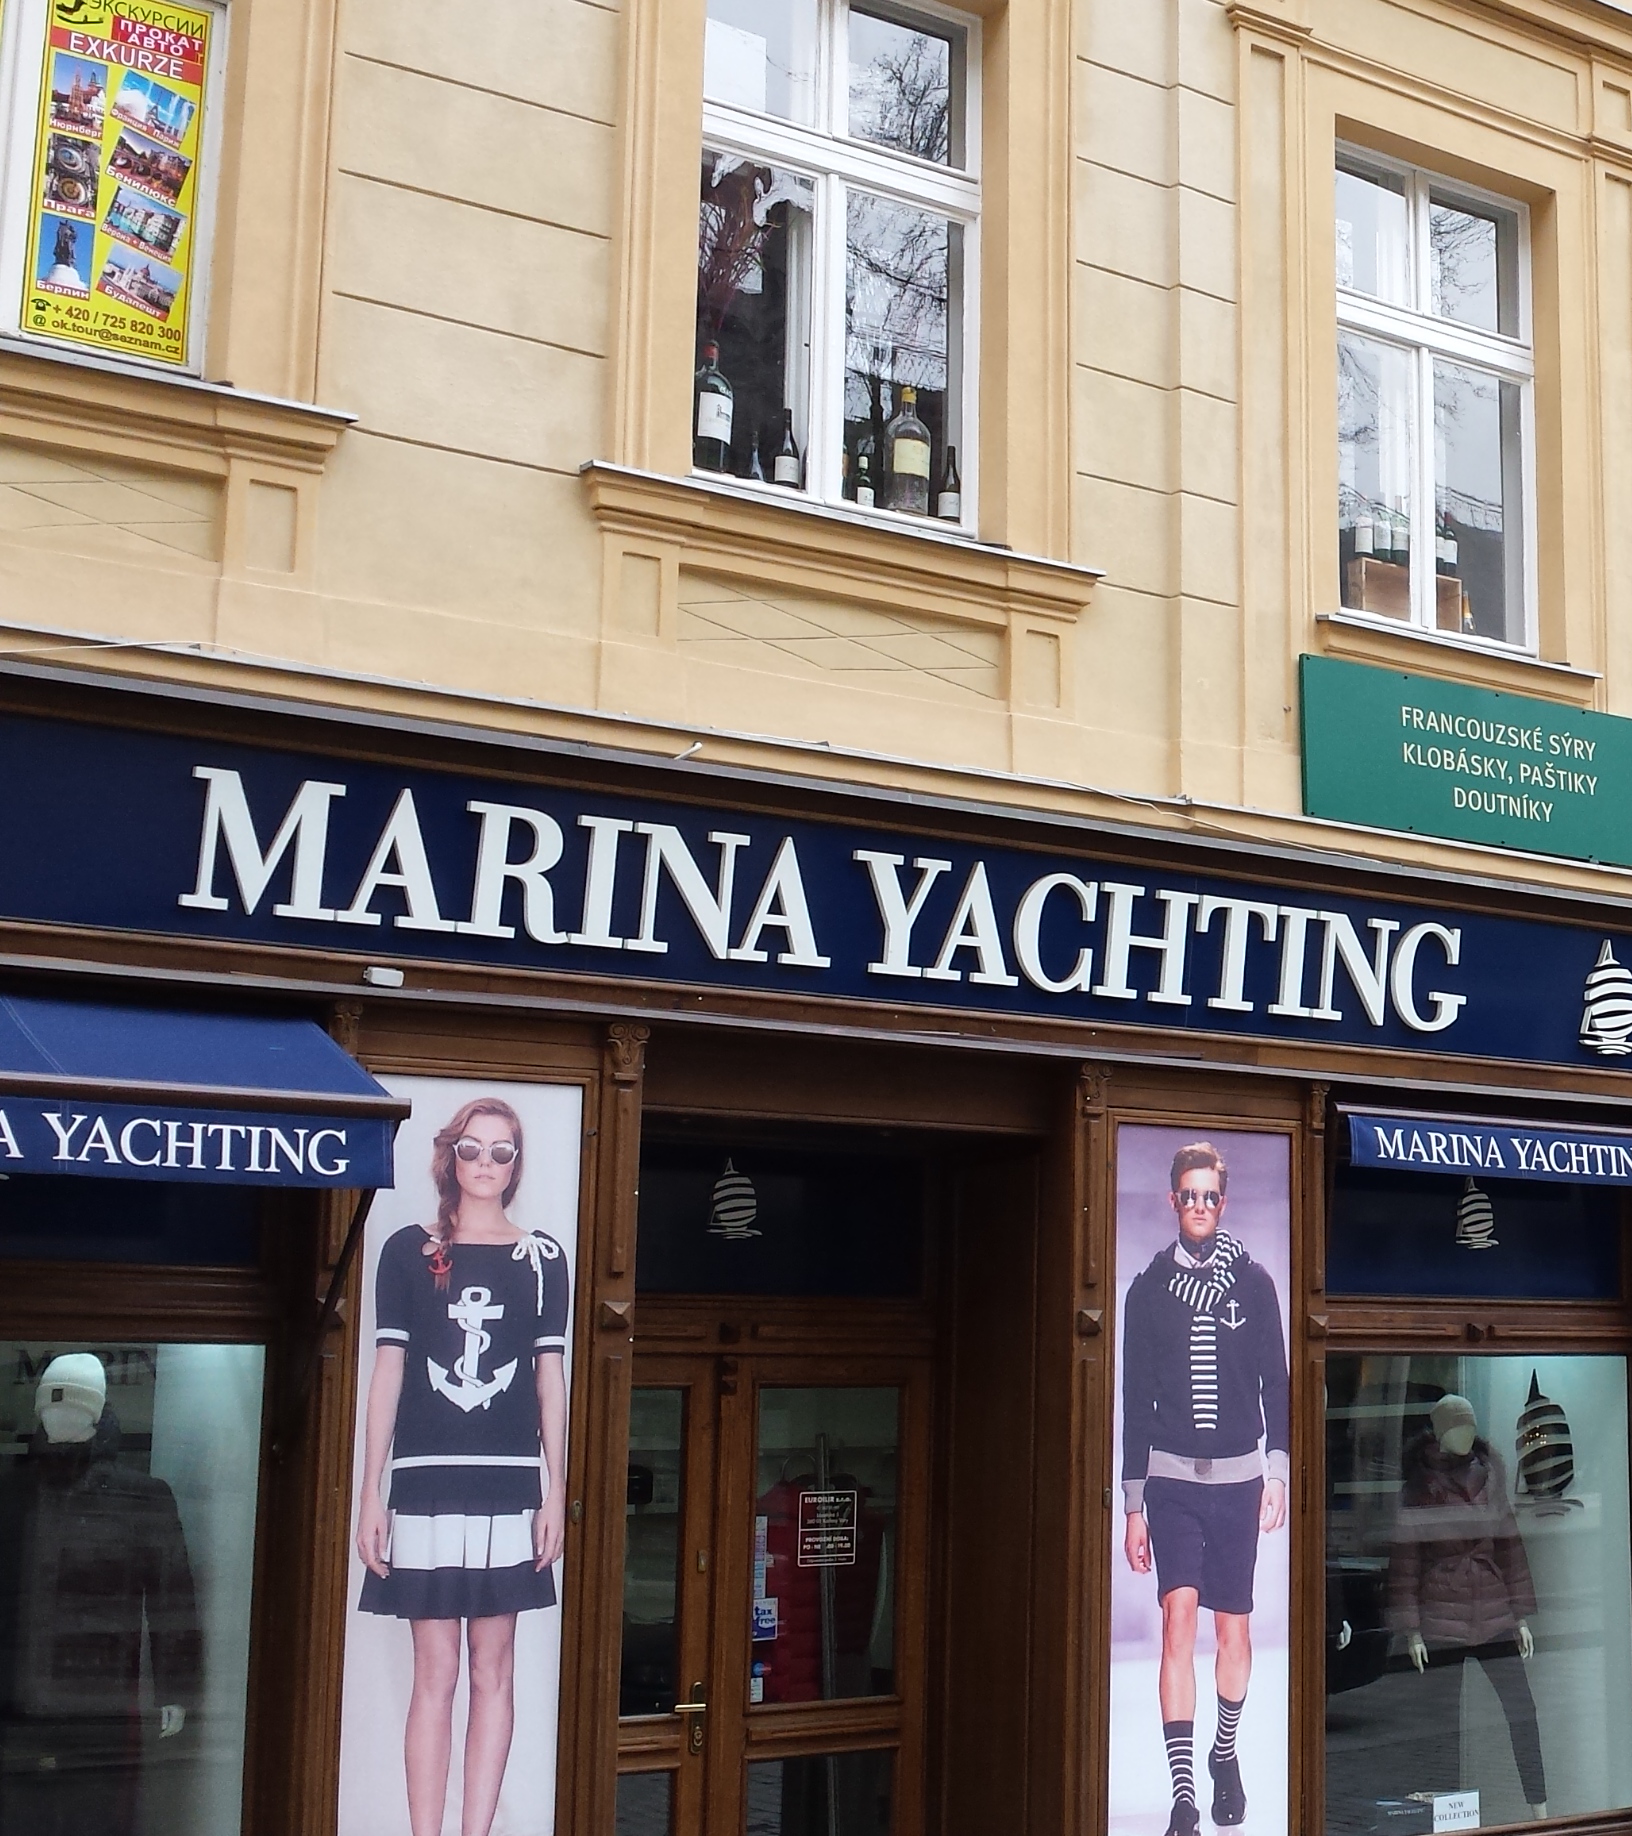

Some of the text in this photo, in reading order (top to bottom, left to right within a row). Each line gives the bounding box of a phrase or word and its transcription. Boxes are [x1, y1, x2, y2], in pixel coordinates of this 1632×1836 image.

[89, 0, 204, 37] ЭКСКУРСИИ
[120, 19, 203, 51] ПРОКАТ
[69, 31, 184, 80] EXKURZE
[127, 33, 184, 56] АВТО
[105, 165, 177, 207] Бенилюкс
[43, 198, 95, 218] Прага
[36, 280, 90, 300] Берлин
[104, 285, 162, 318] Будапешт
[65, 305, 90, 322] 420
[102, 313, 126, 330] 725
[130, 319, 154, 336] 820
[157, 325, 181, 342] 300
[1401, 705, 1597, 762] FRANCOUZSKÉ SÝRY
[1402, 741, 1598, 796] KLOBÁSKY, PAŠTIKY
[1453, 786, 1554, 823] DOUTNÍKY
[178, 765, 1468, 1032] MARINA YACHTING
[41, 1111, 351, 1176] YACHTING
[1373, 1126, 1506, 1169] MARINA
[754, 1605, 773, 1617] tax
[755, 1616, 776, 1627] free
[1433, 1808, 1479, 1823] COLLECTION
[1448, 1800, 1464, 1810] NEW
